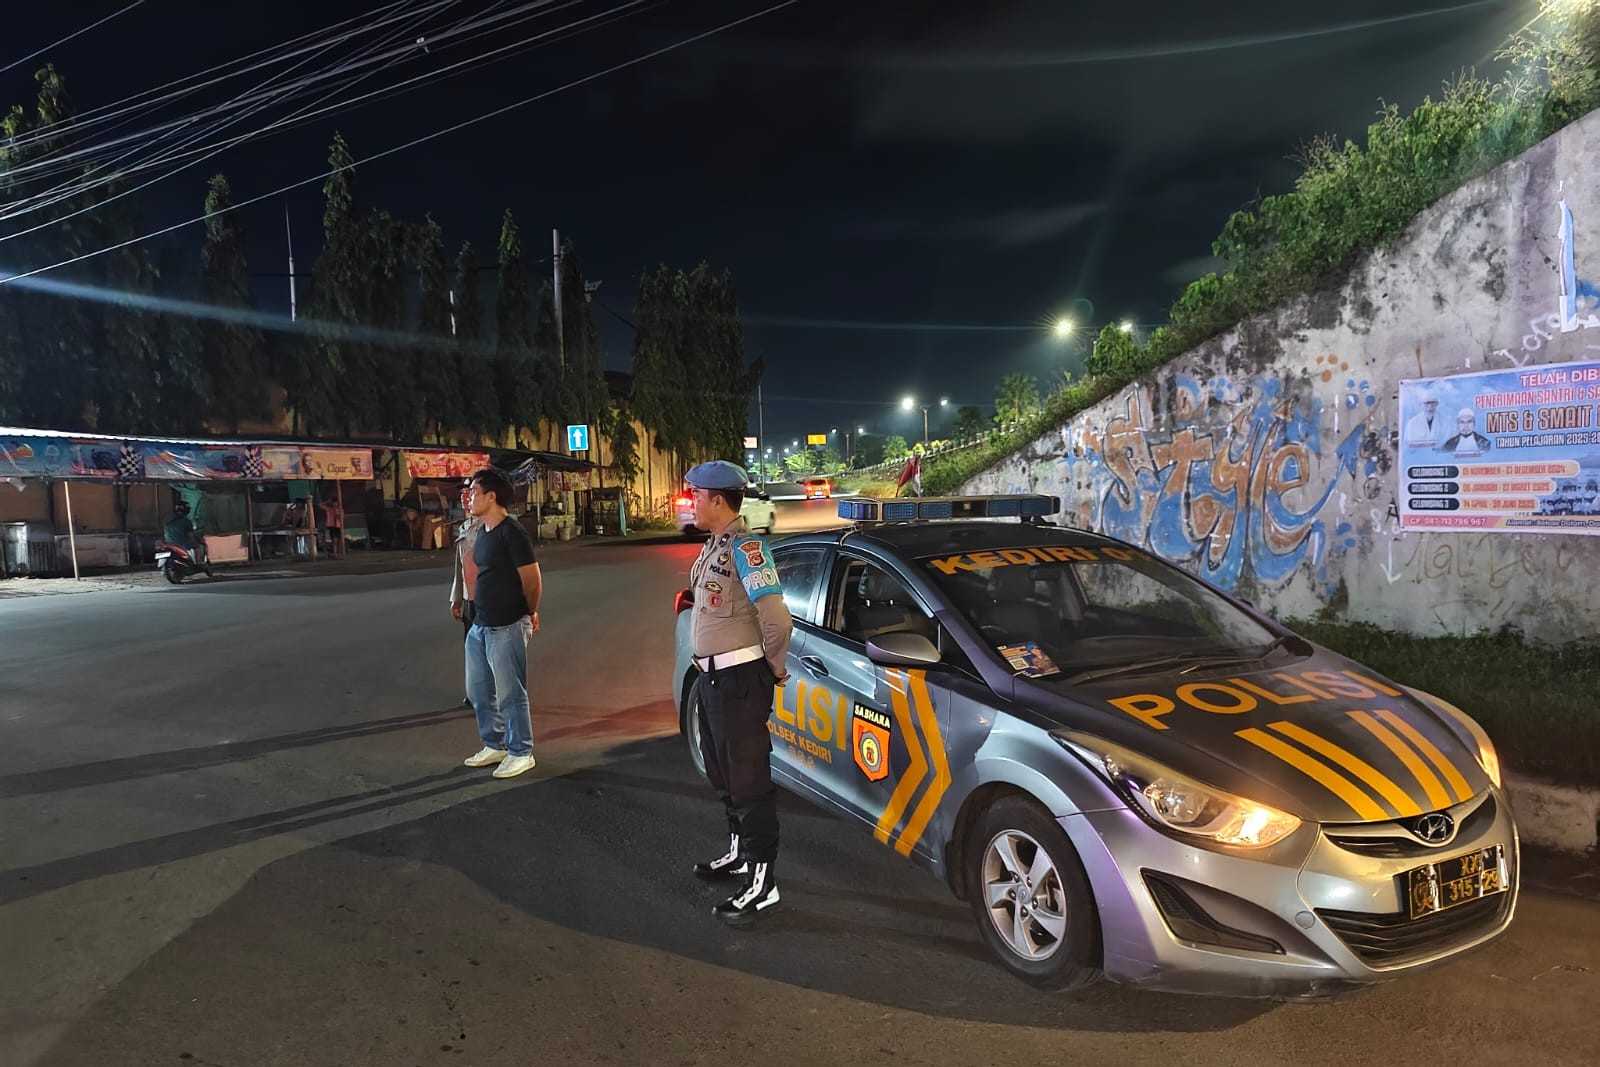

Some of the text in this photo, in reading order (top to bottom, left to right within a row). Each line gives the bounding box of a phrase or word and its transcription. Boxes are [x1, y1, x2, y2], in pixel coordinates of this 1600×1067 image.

[1520, 368, 1600, 387] TELAH DIB
[1536, 387, 1574, 405] SANTRI
[1487, 404, 1593, 434] MTS & SMAIT
[1496, 436, 1520, 449] TAHUN
[1521, 434, 1565, 448] PELAJARAN
[930, 546, 1100, 576] KEDIRI
[1108, 669, 1404, 731] POLISI
[775, 679, 849, 752] LISI
[854, 704, 891, 729] SABHARA
[767, 719, 797, 745] OLSEK
[798, 735, 833, 764] KEDIRI
